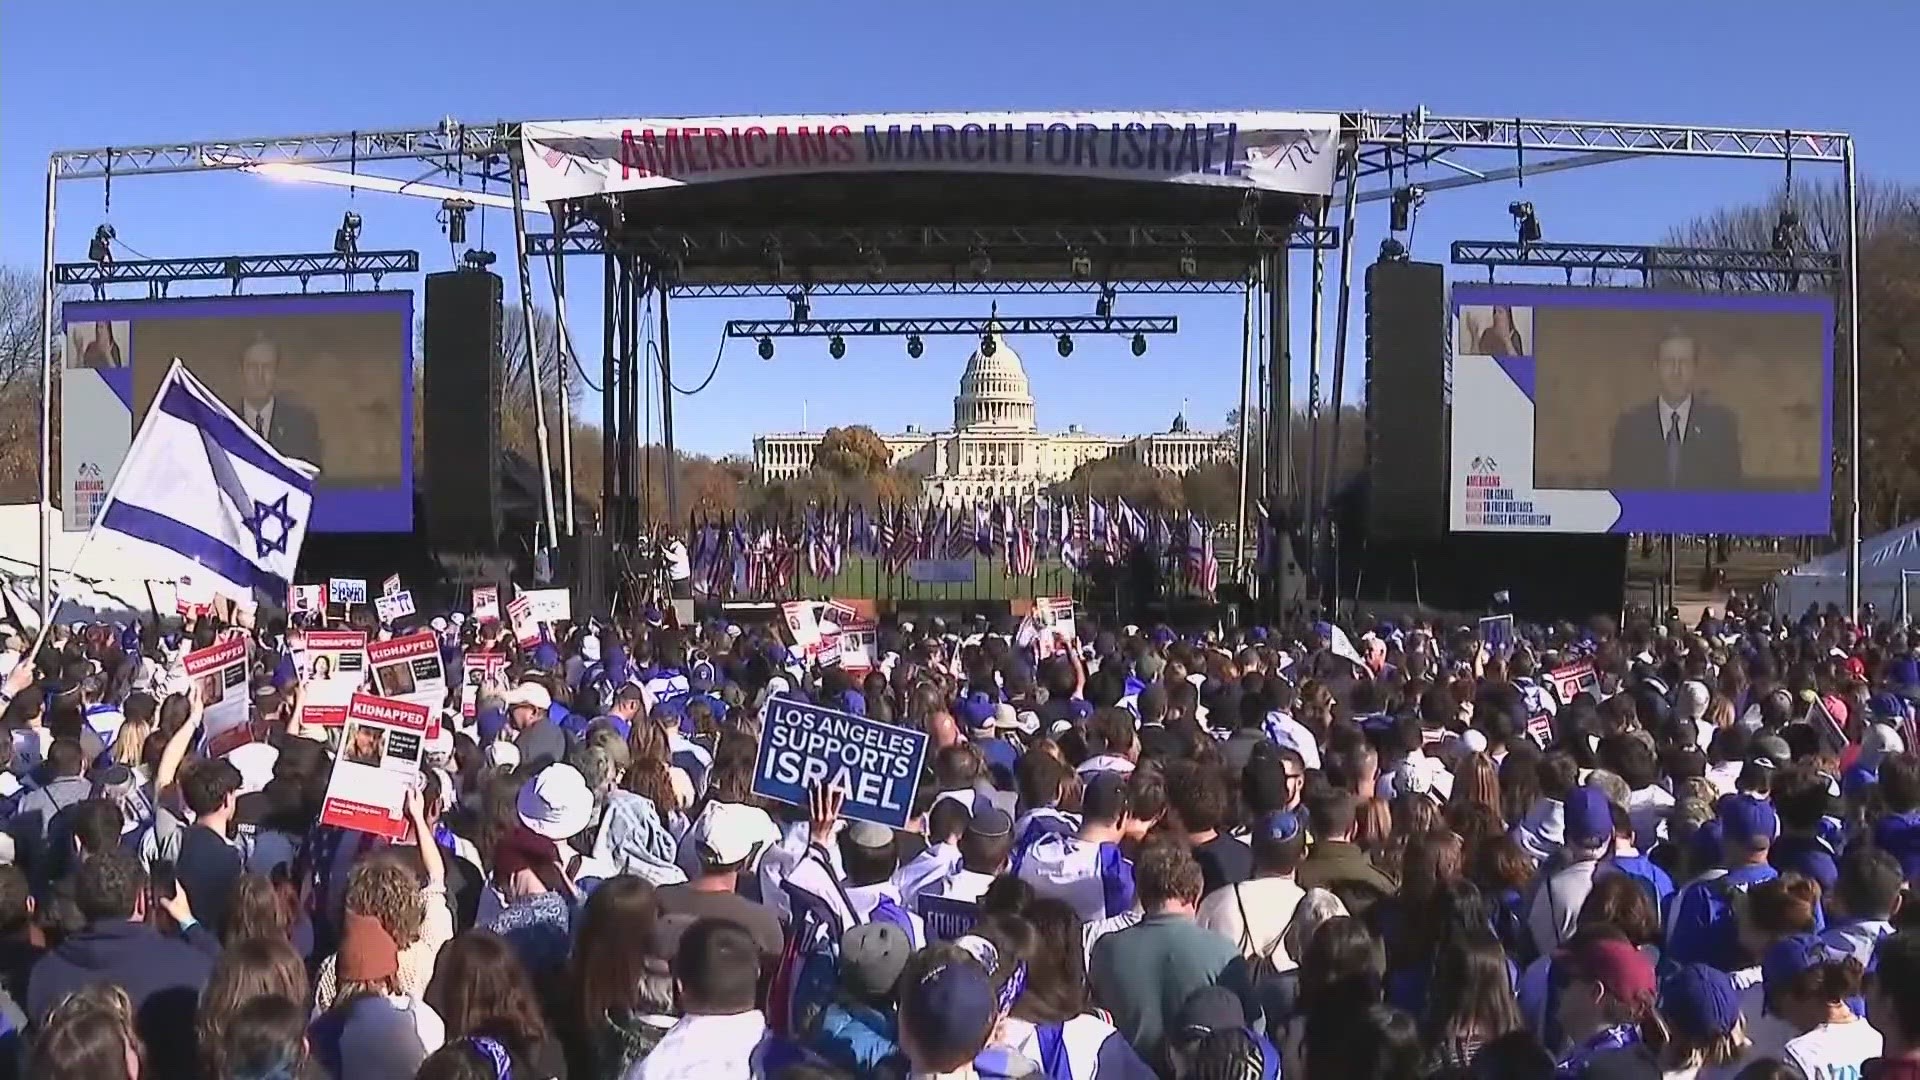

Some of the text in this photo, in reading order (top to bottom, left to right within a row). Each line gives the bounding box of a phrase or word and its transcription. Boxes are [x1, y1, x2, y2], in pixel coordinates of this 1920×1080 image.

[621, 122, 1242, 180] AMERICANS MARCH FOR ISRAEL
[187, 645, 244, 672] KIDNAPPED
[371, 640, 434, 660] KIDNAPPED
[353, 702, 425, 726] KIDNAPPED
[774, 706, 915, 756] LOS ANGELES
[771, 726, 911, 778] SUPPORTS
[764, 747, 901, 811] ISRAEL
